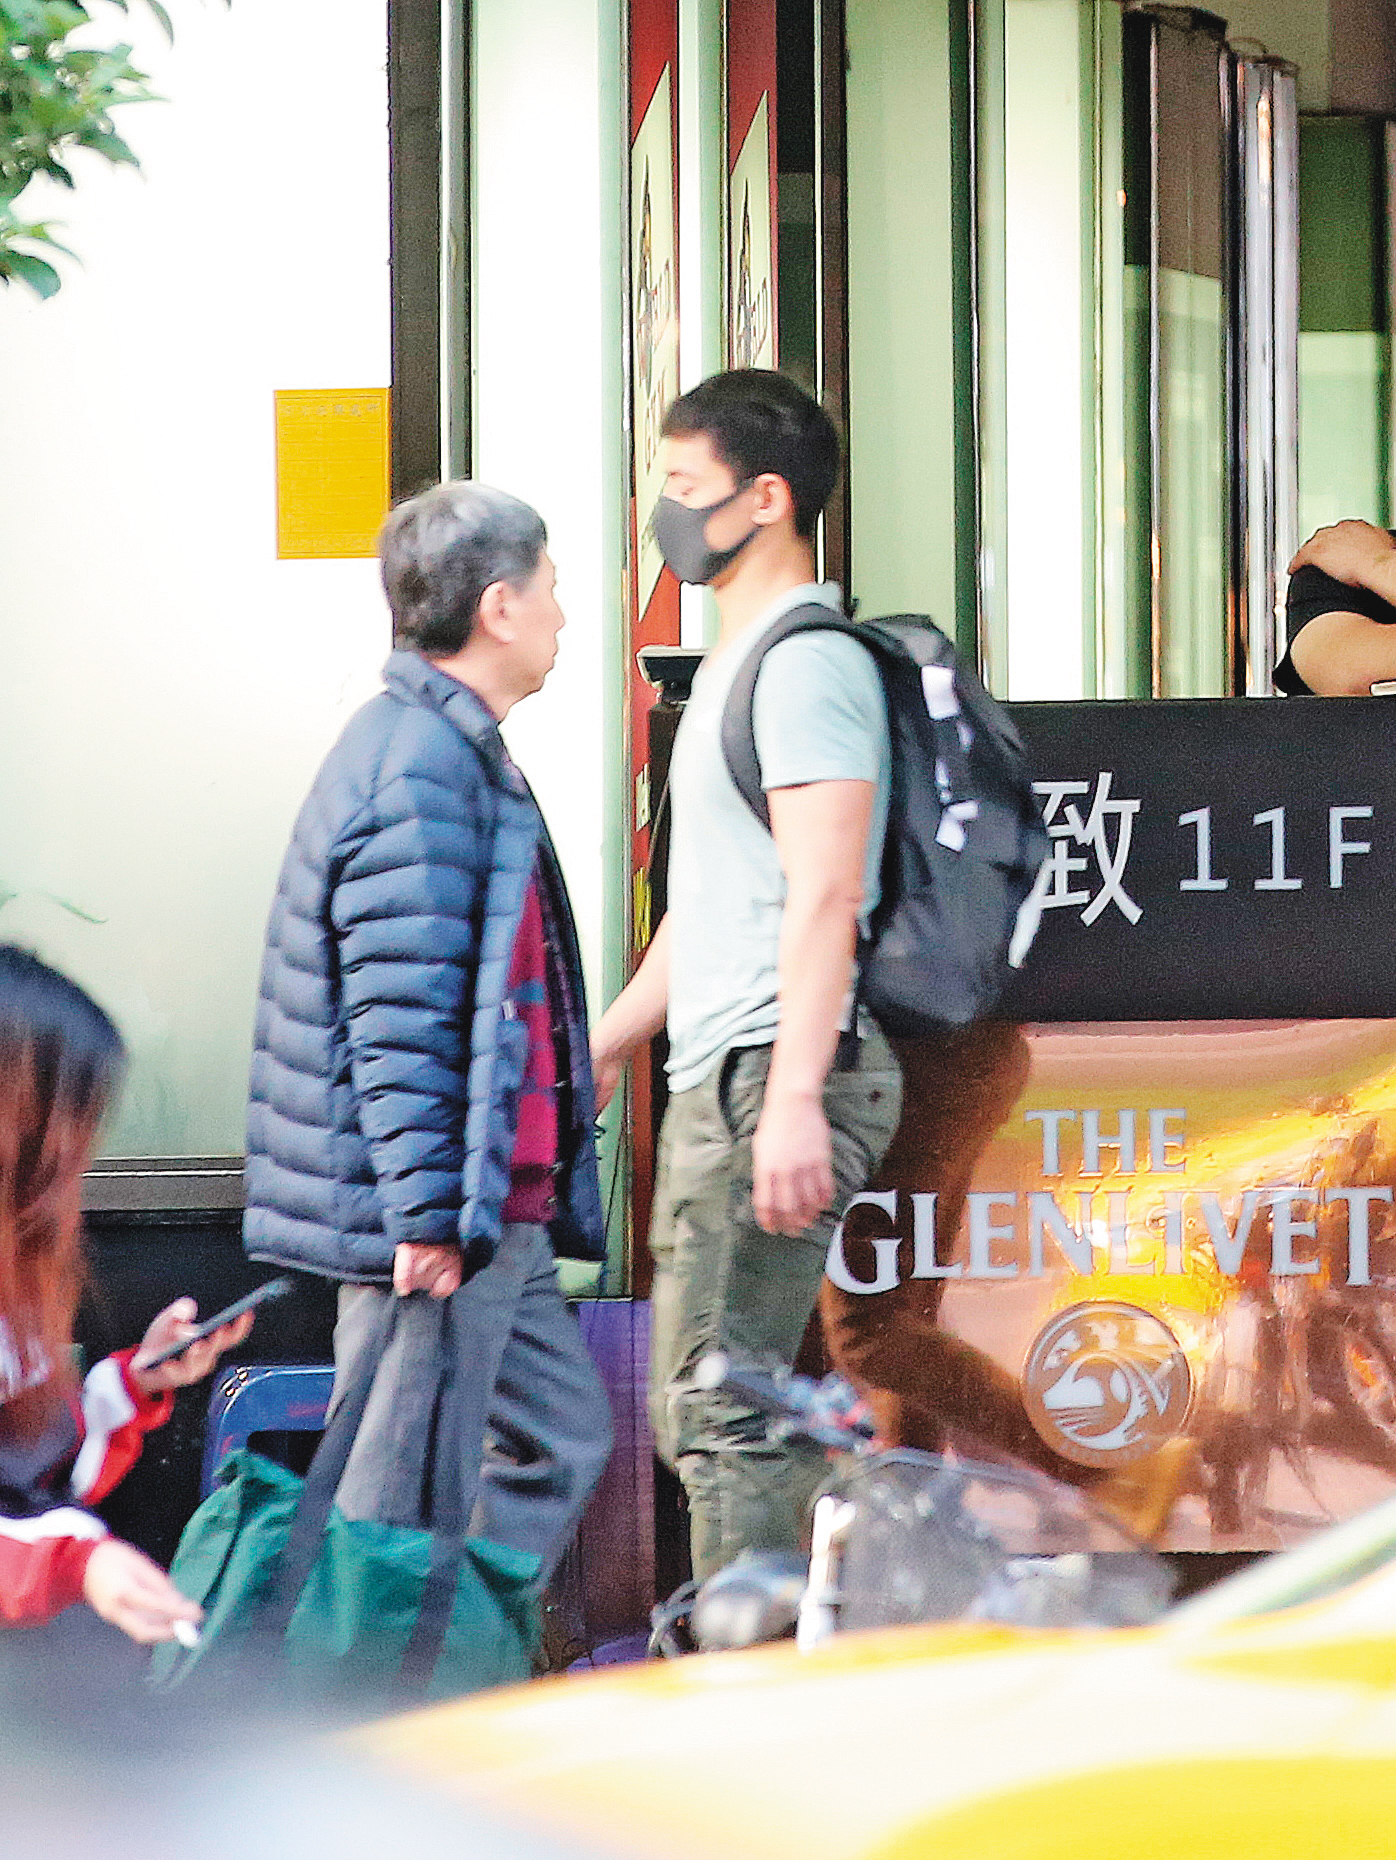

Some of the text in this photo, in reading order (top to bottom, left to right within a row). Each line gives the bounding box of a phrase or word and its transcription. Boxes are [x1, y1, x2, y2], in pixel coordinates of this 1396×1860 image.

[1031, 771, 1374, 927] 致 11F
[1026, 1109, 1188, 1177] THE
[826, 1188, 1393, 1294] GLENLIVET
